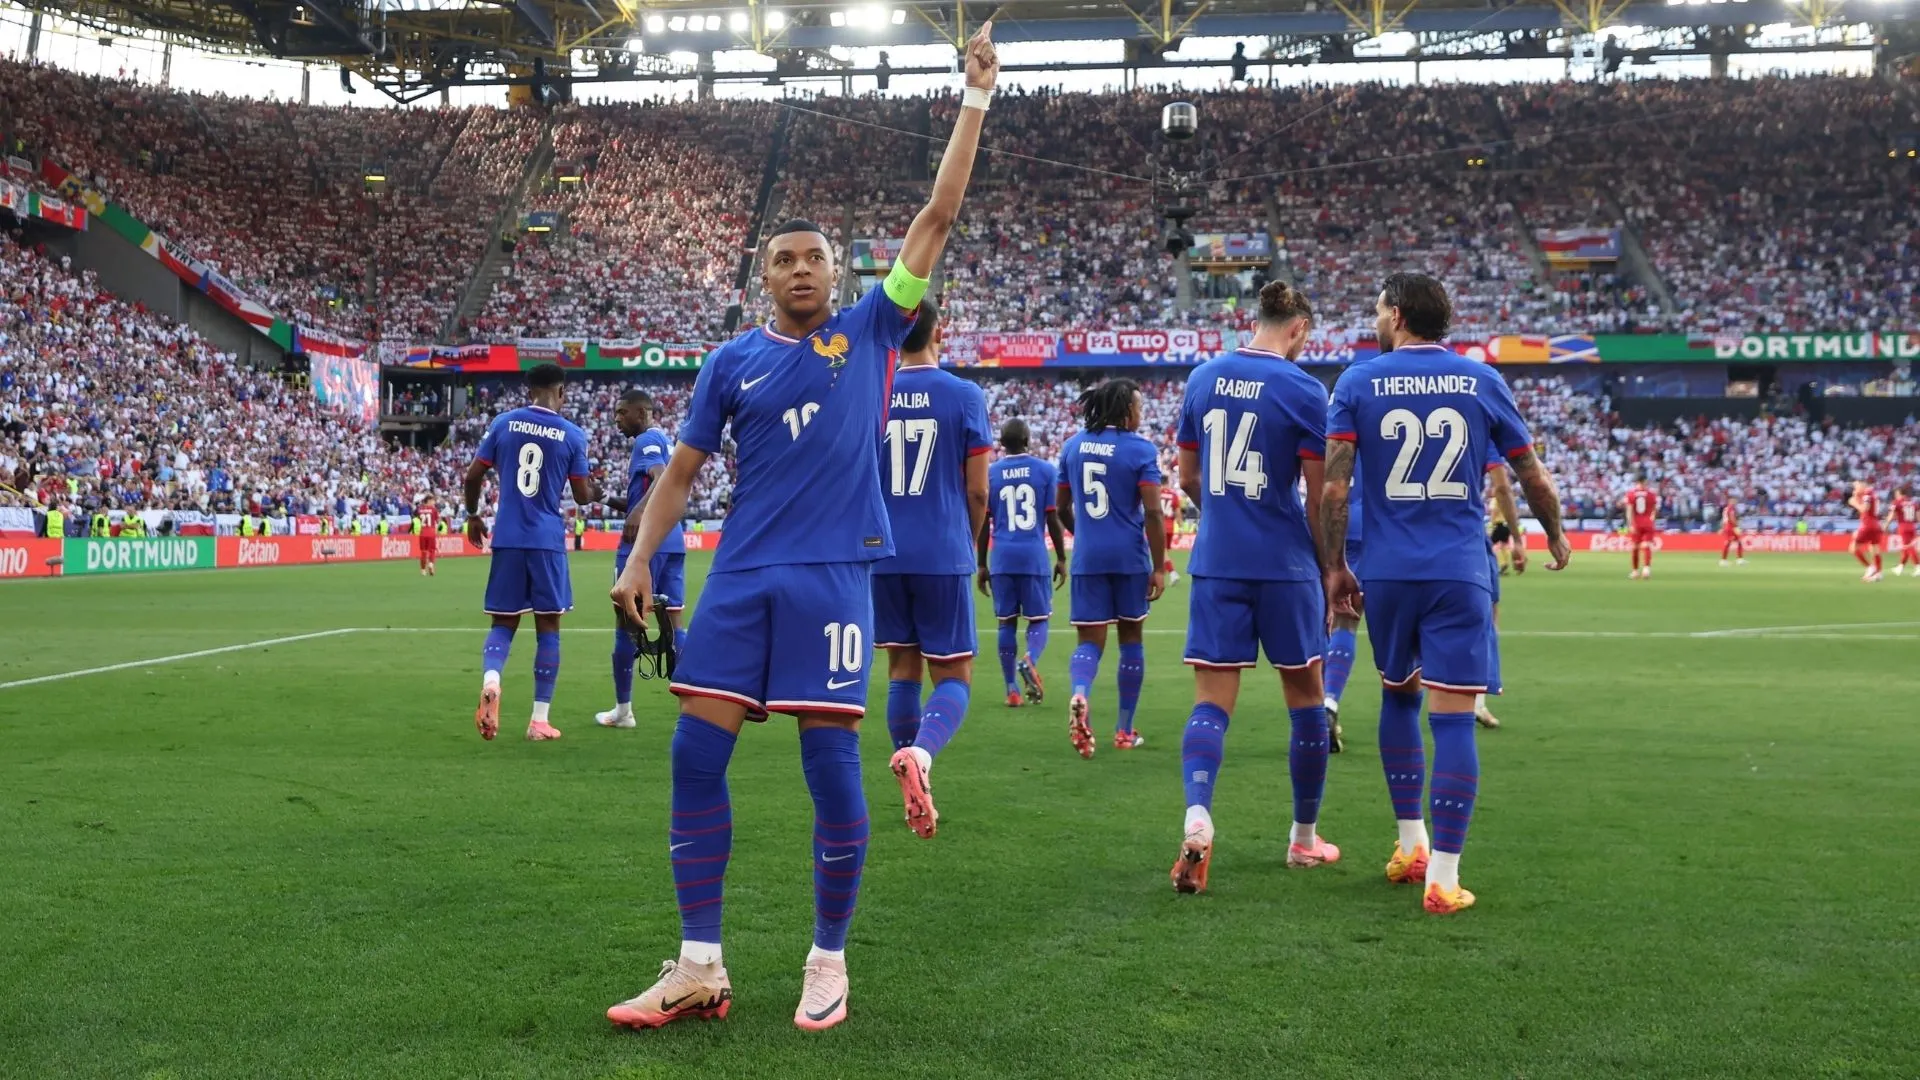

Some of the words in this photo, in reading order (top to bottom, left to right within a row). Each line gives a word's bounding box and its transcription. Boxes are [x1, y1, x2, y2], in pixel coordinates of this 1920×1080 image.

[1715, 335, 1920, 358] DORTMUND
[1215, 377, 1264, 399] RABIOT
[1371, 375, 1477, 396] T.HERNANDEZ
[508, 421, 566, 442] TCHOUAMENI
[884, 419, 938, 496] 17
[1080, 442, 1115, 457] KOUNDE
[1203, 409, 1267, 500] 14
[1381, 407, 1468, 500] 22
[517, 442, 543, 497] 8
[1002, 467, 1030, 480] KANTE
[1083, 462, 1109, 519] 5
[420, 514, 432, 526] 21
[1000, 484, 1036, 532] 13
[87, 540, 198, 570] DORTMUND
[237, 538, 279, 564] Betano
[1590, 533, 1663, 551] Betao
[824, 622, 862, 673] 10
